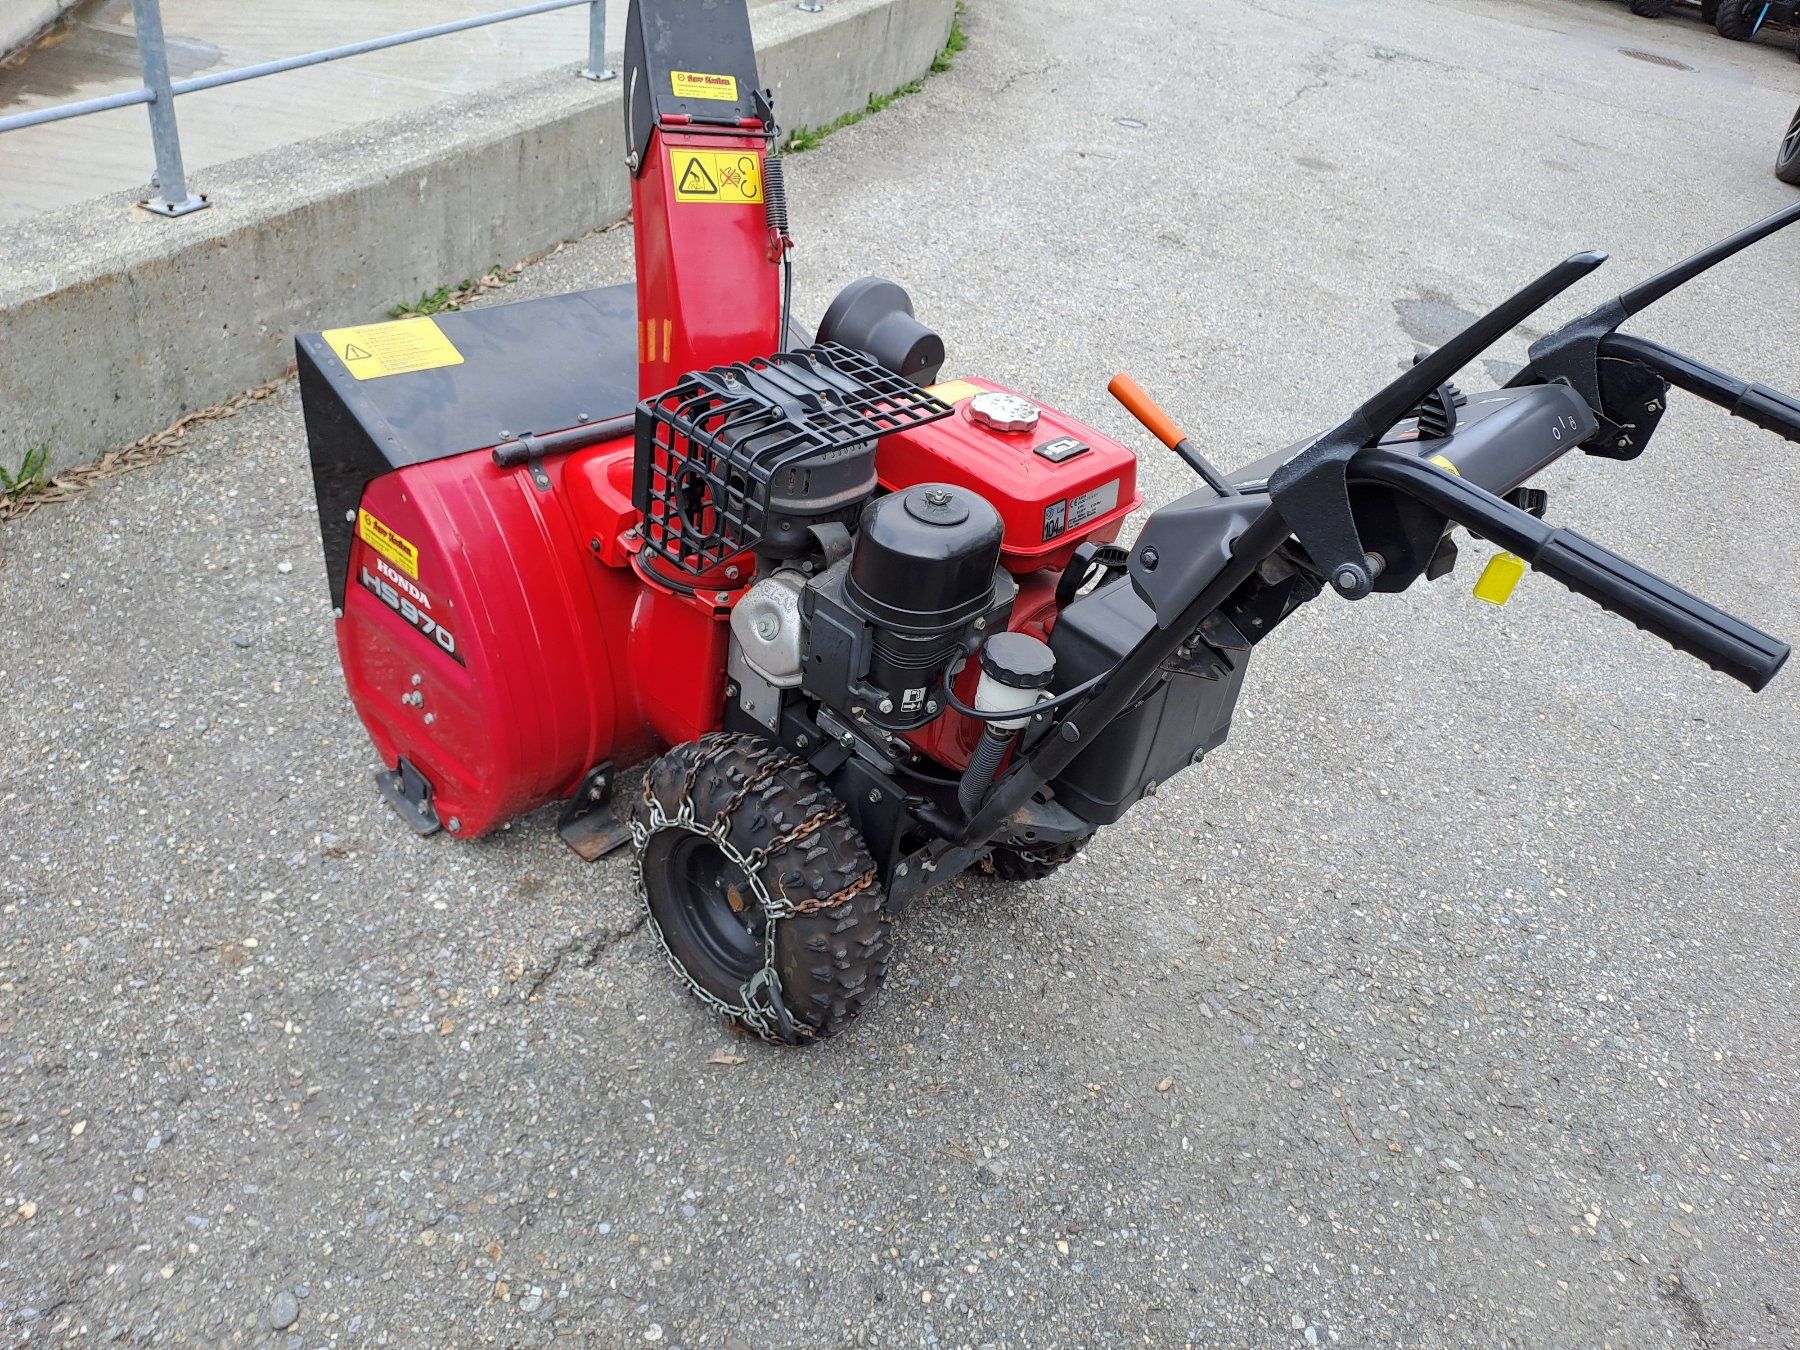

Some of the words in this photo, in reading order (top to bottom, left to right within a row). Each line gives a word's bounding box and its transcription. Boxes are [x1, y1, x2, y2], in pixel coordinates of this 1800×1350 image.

[1044, 517, 1059, 539] 104
[361, 565, 455, 653] HS970
[376, 557, 432, 610] HONDA
